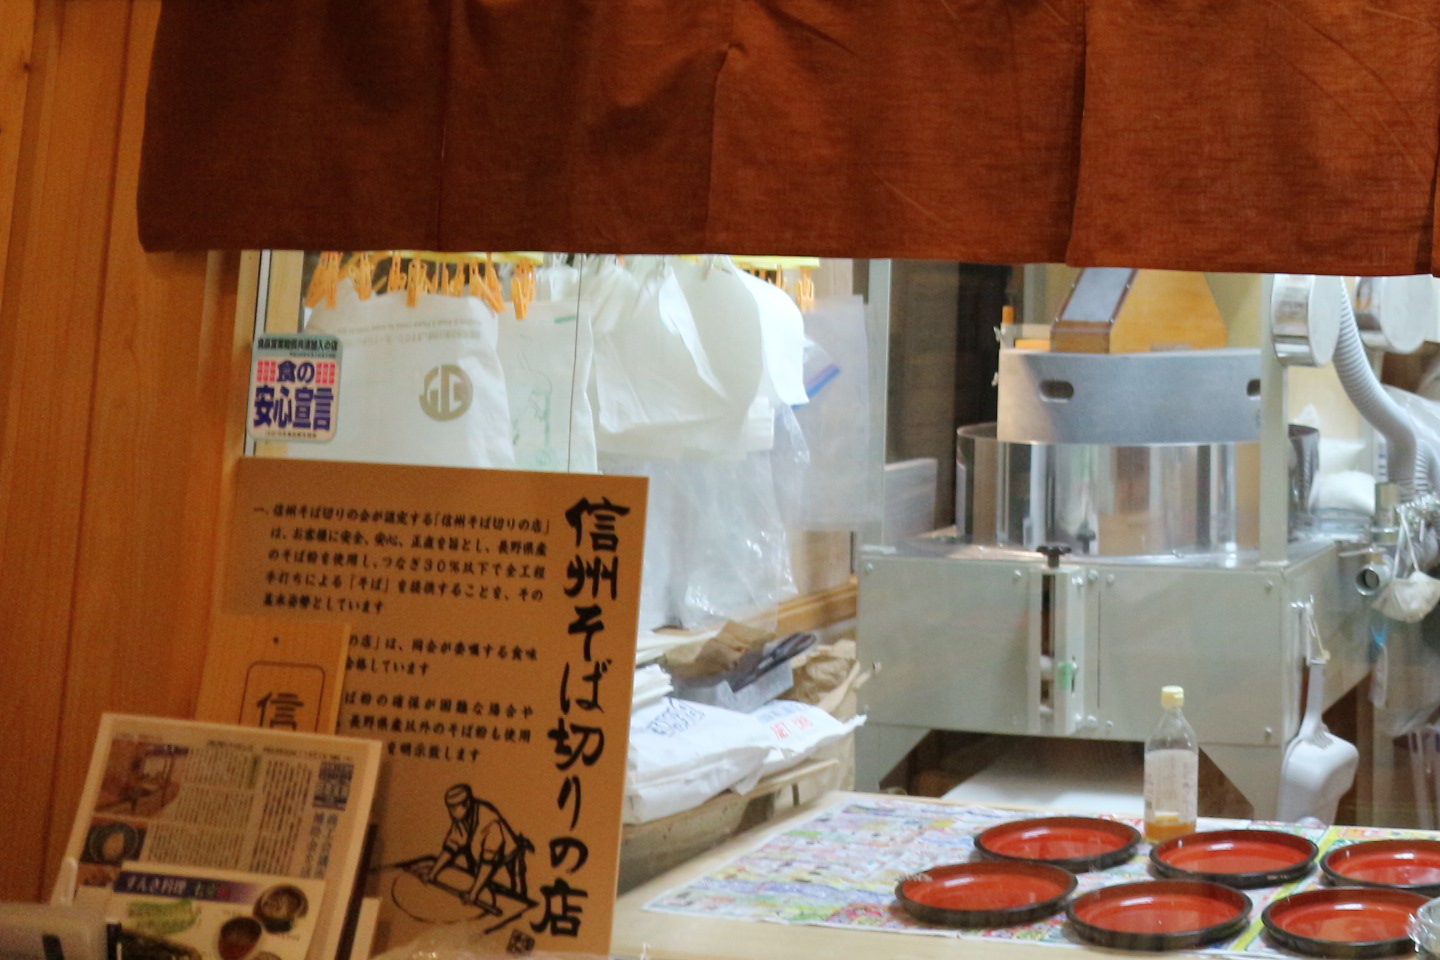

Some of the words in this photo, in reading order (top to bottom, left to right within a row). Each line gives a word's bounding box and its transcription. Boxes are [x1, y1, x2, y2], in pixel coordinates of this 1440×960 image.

[277, 360, 315, 383] 食の
[254, 384, 334, 431] 安心宣言
[530, 496, 631, 938] 信州そば切りの店
